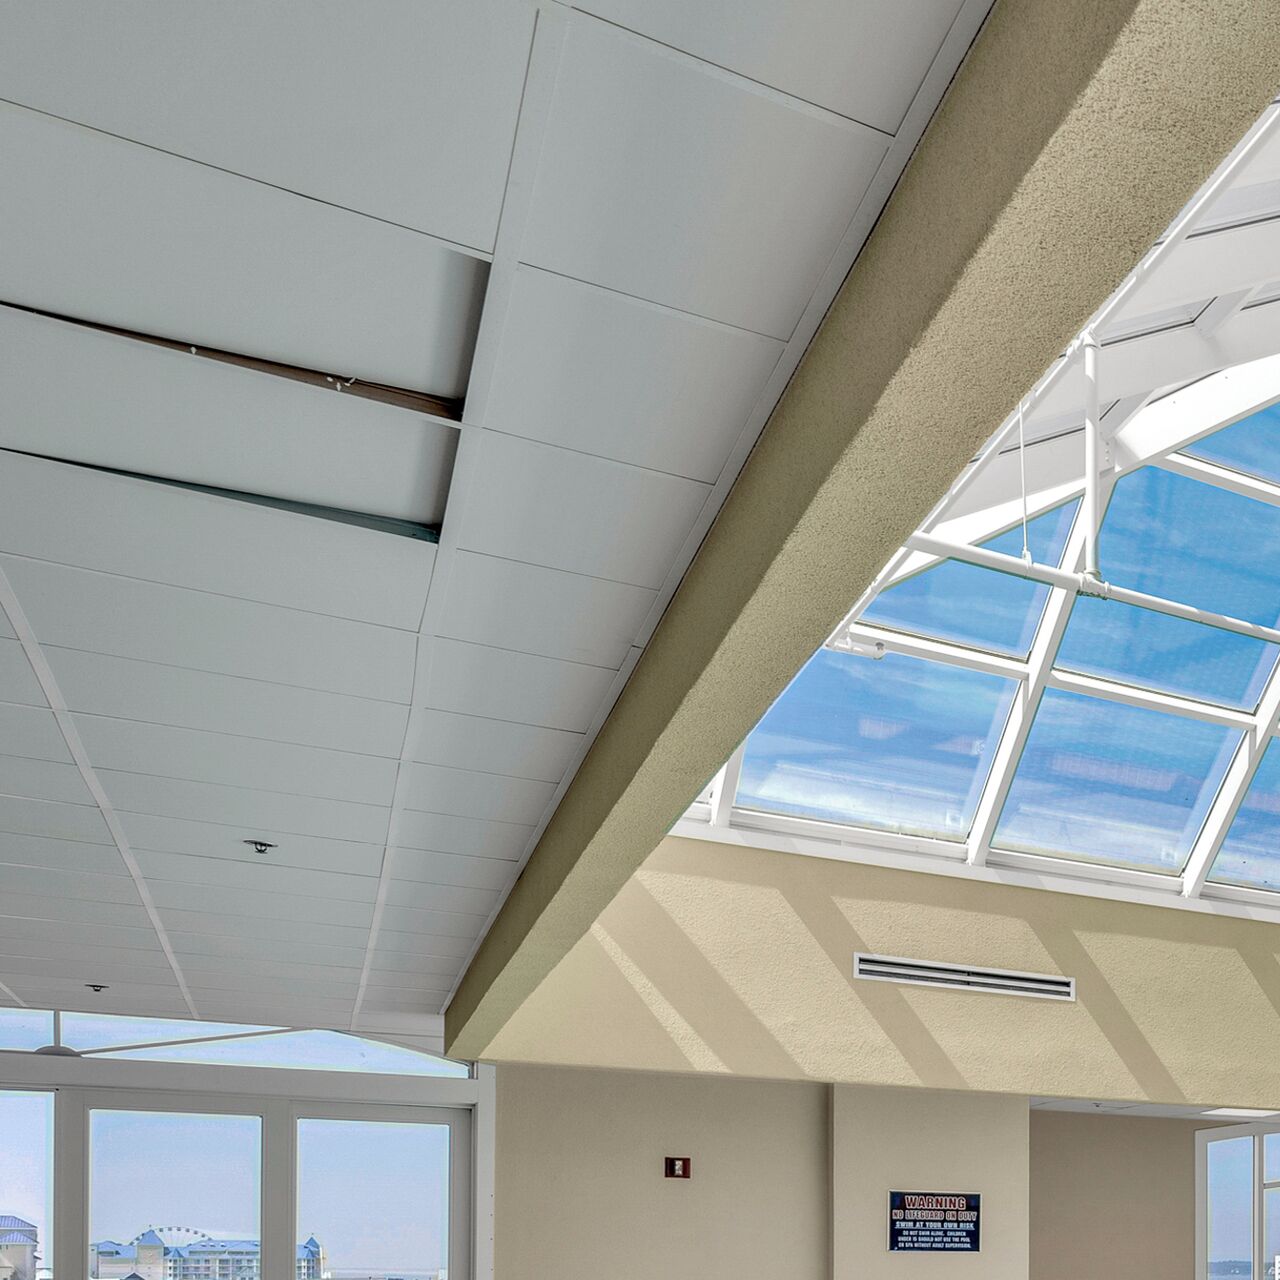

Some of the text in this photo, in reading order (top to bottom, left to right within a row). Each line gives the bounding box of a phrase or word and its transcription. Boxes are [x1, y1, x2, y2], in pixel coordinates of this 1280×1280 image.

[905, 1195, 966, 1210] WARNING
[892, 1209, 977, 1221] NO LIFEGUARD ON DUTY
[925, 1221, 942, 1229] YOUR
[959, 1222, 975, 1230] RISK
